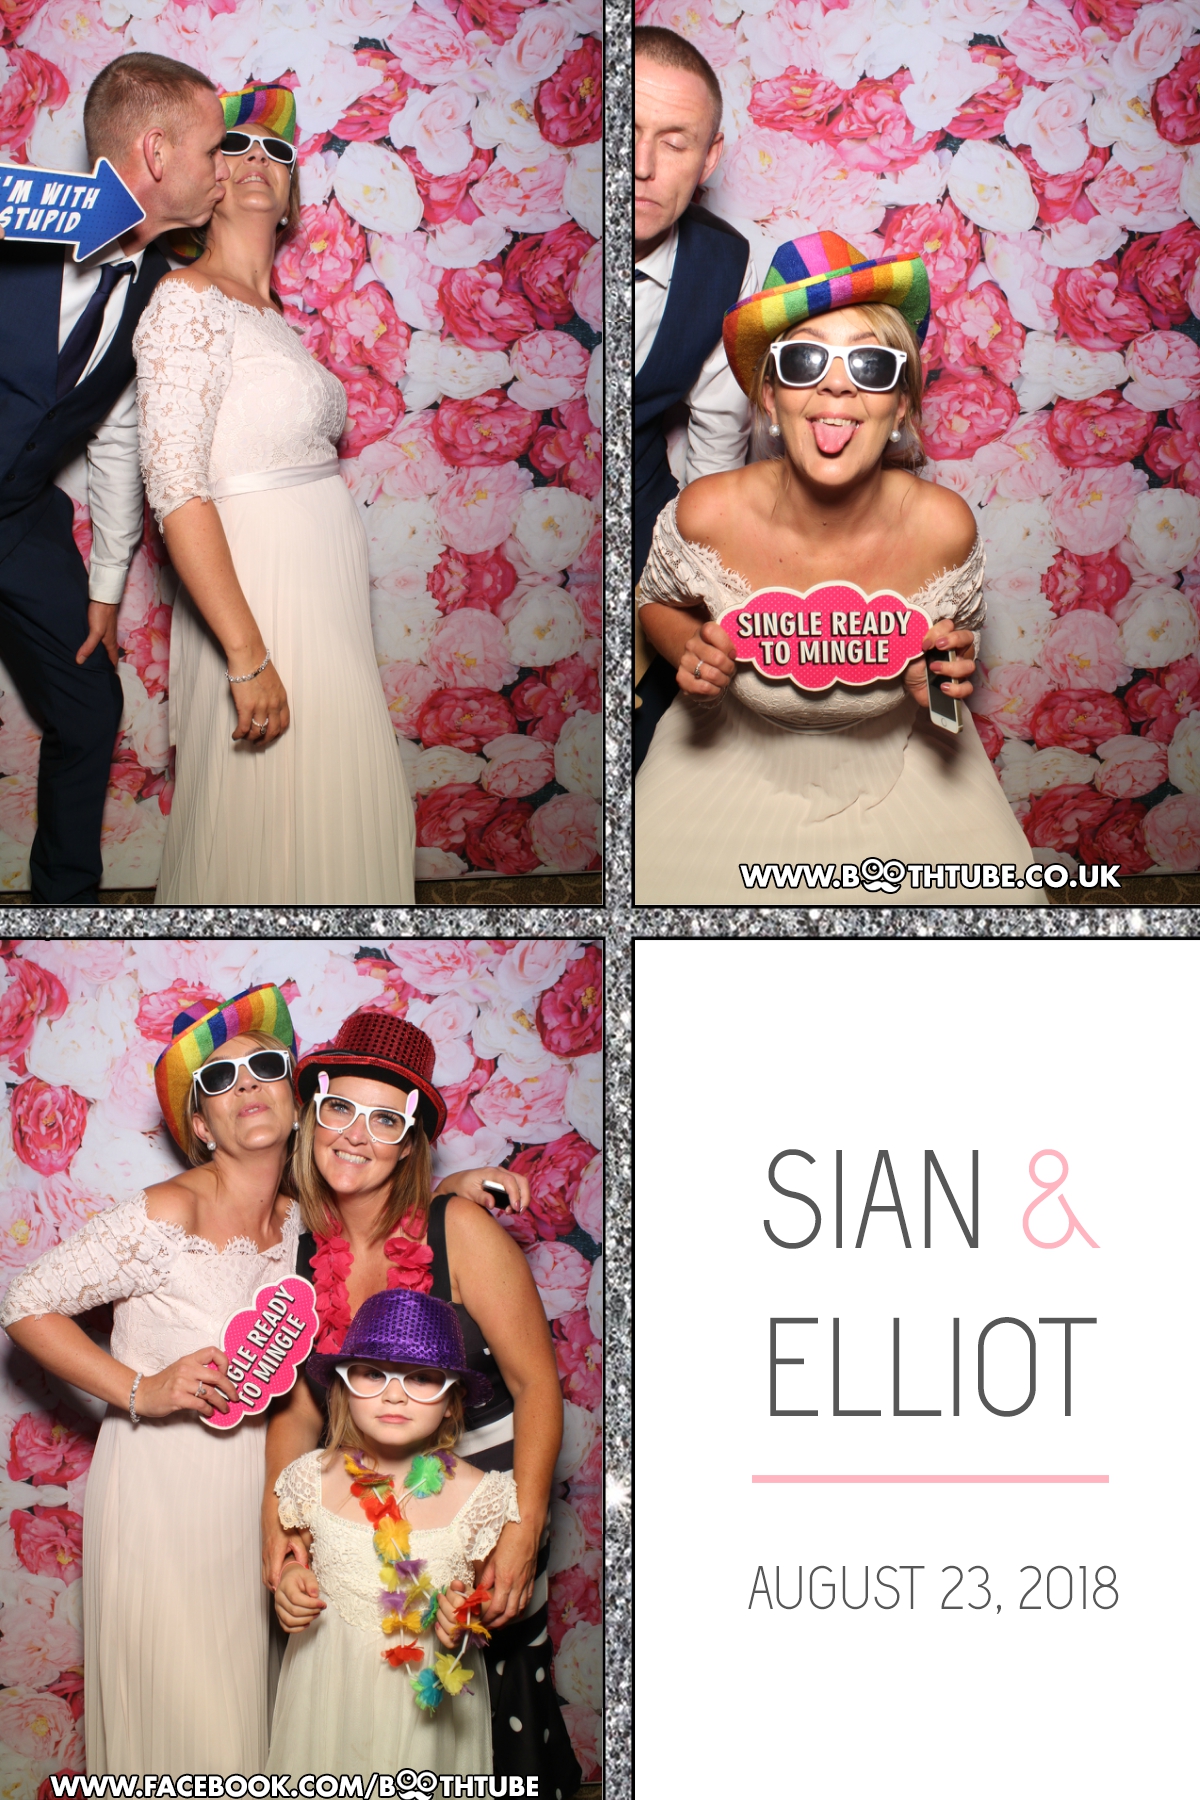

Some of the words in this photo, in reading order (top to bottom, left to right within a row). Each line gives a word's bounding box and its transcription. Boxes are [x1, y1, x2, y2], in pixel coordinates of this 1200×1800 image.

[0, 175, 34, 205] 'M
[40, 181, 101, 210] WITH
[0, 205, 82, 234] STUPID
[737, 611, 823, 638] SINGLE
[831, 610, 913, 637] READY
[760, 640, 792, 665] TO
[799, 639, 890, 664] MINGLE
[247, 1284, 296, 1348] READY
[238, 1381, 263, 1407] TO
[252, 1313, 307, 1383] MINGLE
